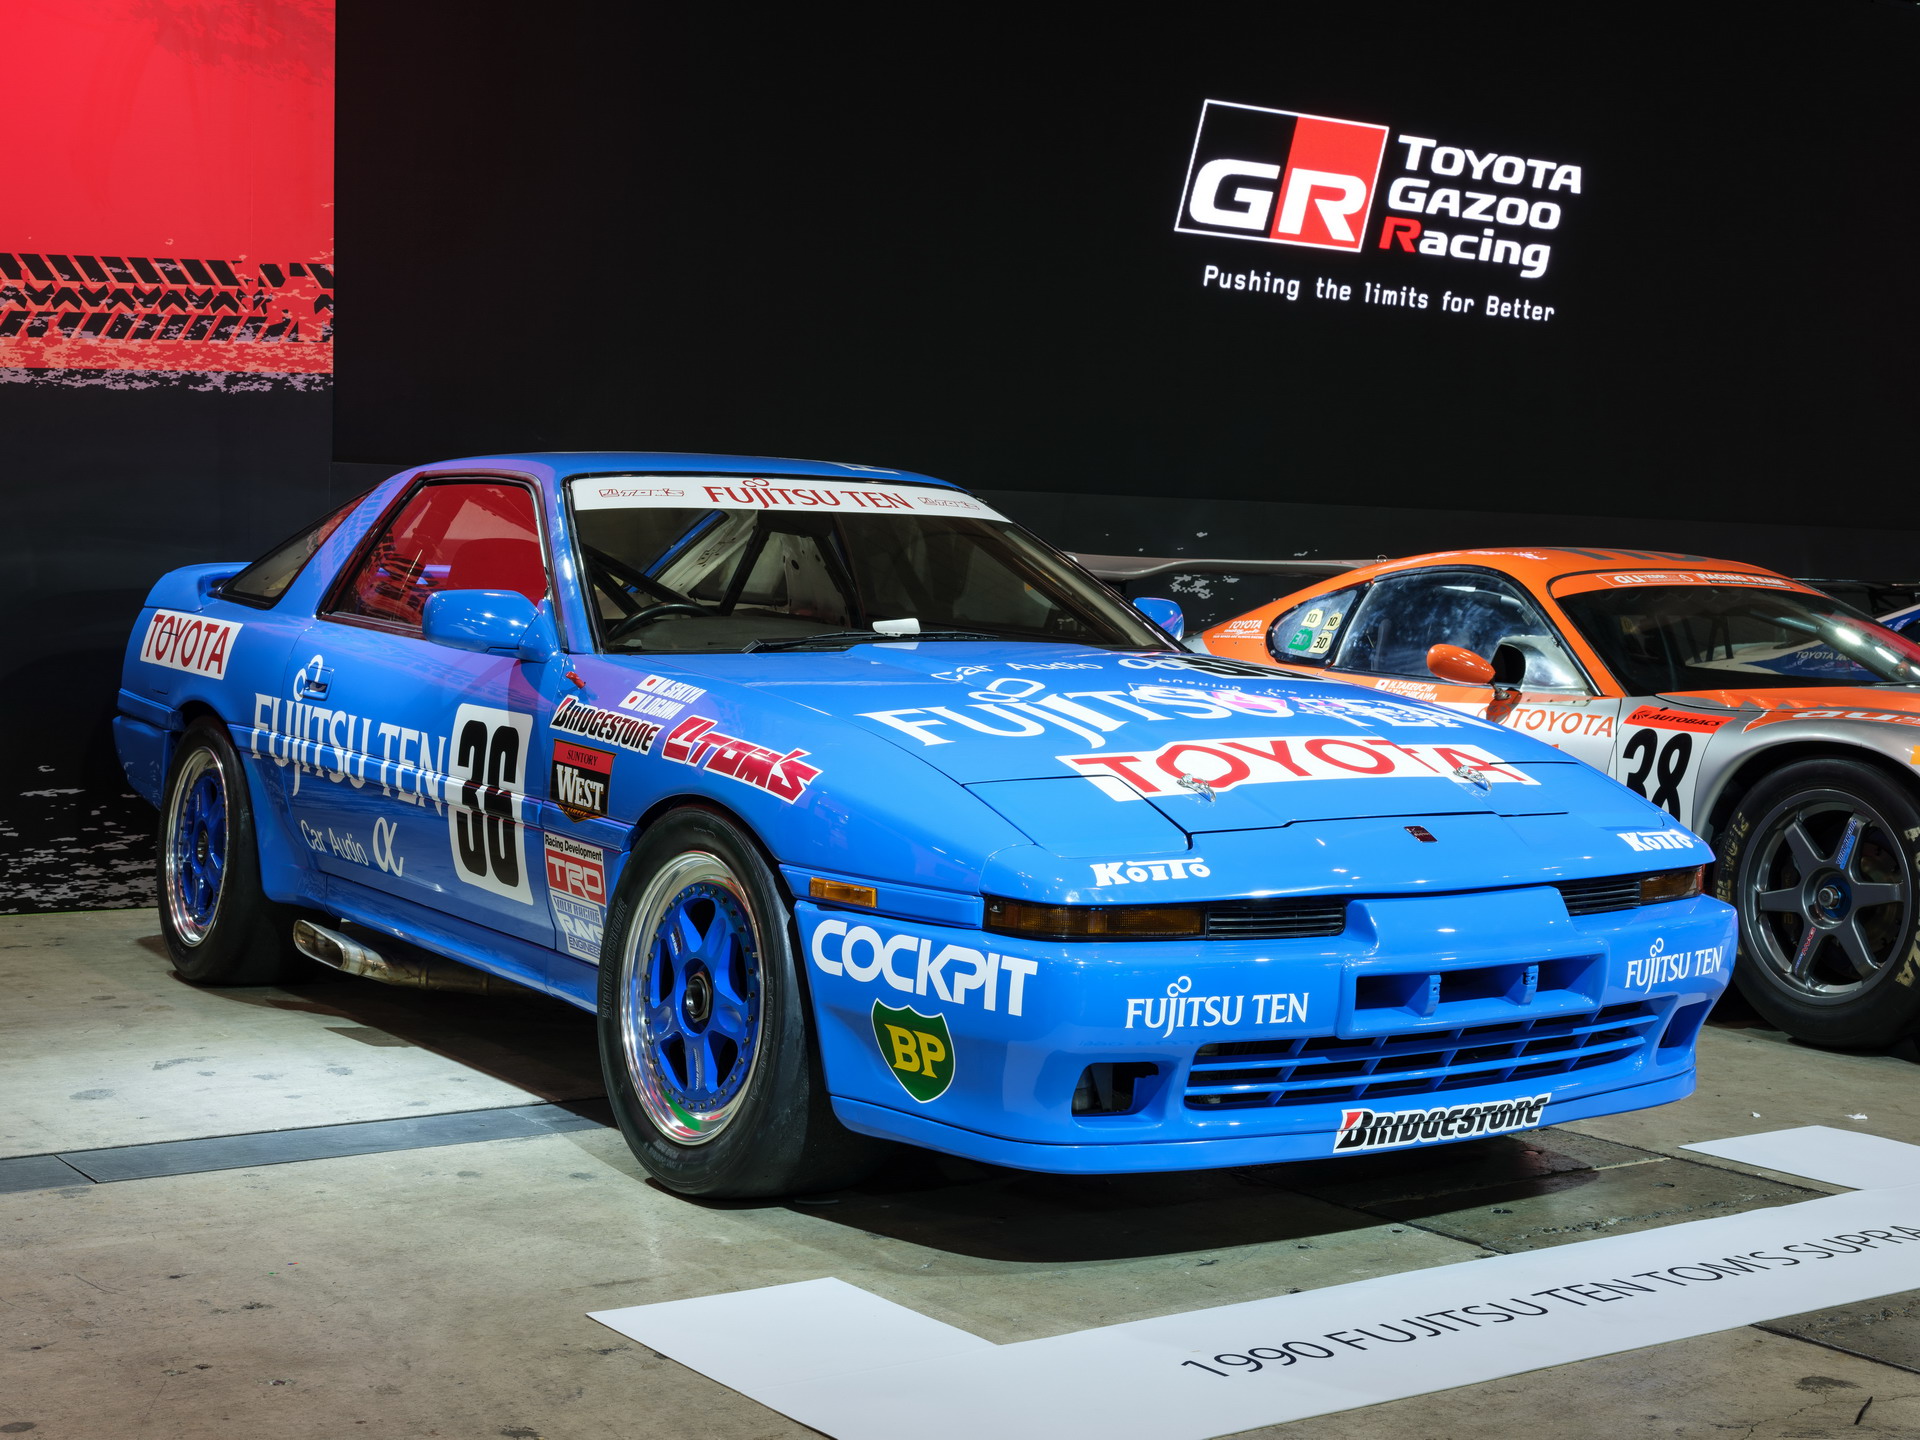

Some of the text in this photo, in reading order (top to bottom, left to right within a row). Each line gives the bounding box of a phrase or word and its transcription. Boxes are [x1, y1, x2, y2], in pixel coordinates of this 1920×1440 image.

[1398, 134, 1582, 194] TOYOTA
[1189, 158, 1367, 242] GR
[1388, 177, 1562, 231] GAZOO
[1378, 215, 1551, 279] Racing
[1203, 265, 1556, 322] Pushing the limits for Better
[702, 484, 915, 510] FUJITSU TEN
[1229, 619, 1263, 629] TOYOTA
[1306, 613, 1318, 624] 10
[1313, 636, 1328, 649] 30
[1327, 616, 1338, 627] 10
[146, 614, 231, 675] TOYOTA
[1796, 651, 1834, 660] TOYOTA
[930, 664, 994, 682] Car
[551, 696, 661, 752] BRIDGESTONE
[854, 689, 1295, 749] FUJITSU
[1513, 707, 1615, 738] TOYOTA
[1648, 713, 1723, 727] AUTOBACS
[251, 693, 447, 817] FUJITSU TEN
[567, 749, 599, 767] SUNTORY
[1071, 738, 1526, 793] TOYOTA
[1622, 728, 1693, 823] 38
[456, 719, 520, 888] 36
[556, 764, 605, 811] WEST
[301, 819, 328, 854] Car
[328, 827, 370, 867] Audio
[545, 835, 603, 862] Racing Development
[548, 856, 603, 900] TRD
[812, 919, 1039, 1018] COCKPIT
[1625, 946, 1723, 995] FUJITSU TEN
[1125, 992, 1310, 1039] FUJITSU TEN
[884, 1023, 946, 1080] BP
[1335, 1094, 1550, 1152] BRIDGESTONE
[1181, 1224, 1920, 1378] 1990 FUJITSU TEN TOM'S SUPRA
